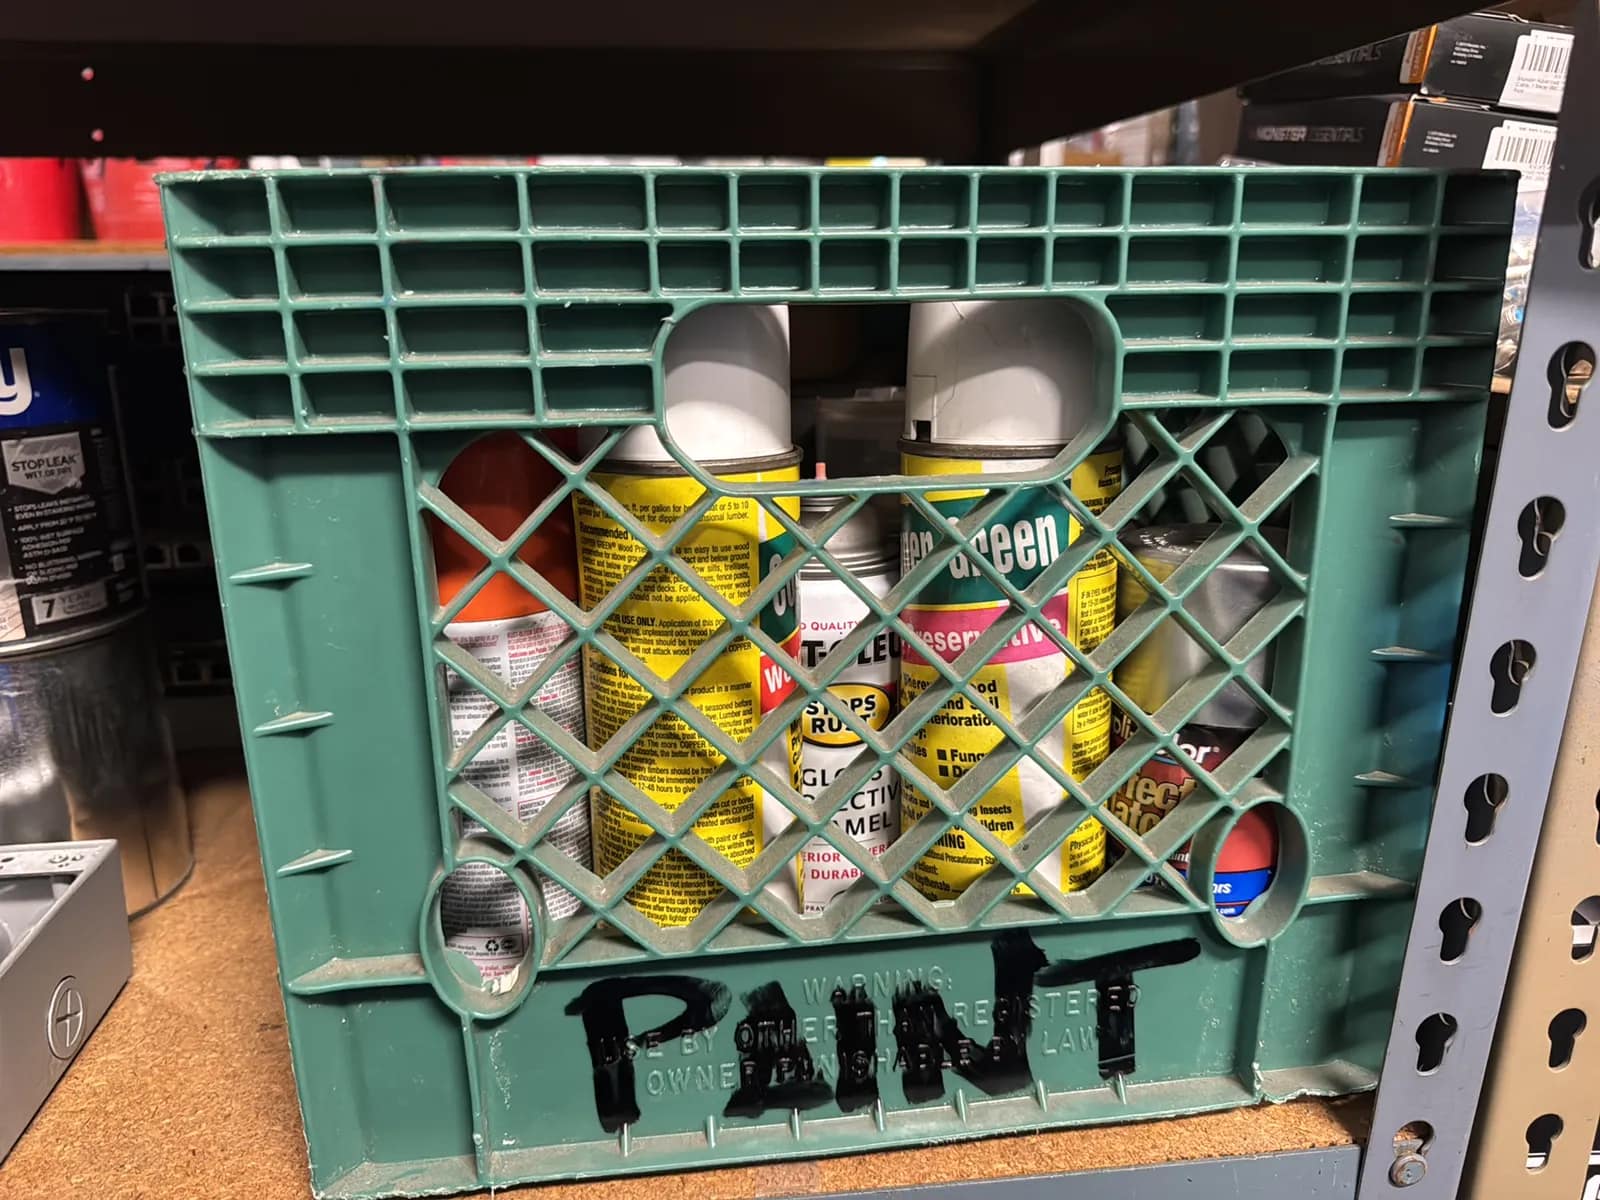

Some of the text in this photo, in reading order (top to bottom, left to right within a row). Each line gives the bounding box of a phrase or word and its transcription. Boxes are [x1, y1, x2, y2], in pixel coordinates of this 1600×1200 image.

[1255, 126, 1307, 142] MONSTER
[651, 504, 671, 513] gallon
[711, 553, 728, 561] below
[730, 552, 749, 561] ground
[42, 600, 56, 618] 7
[621, 614, 634, 624] USE
[637, 616, 656, 626] ONLY.
[660, 620, 693, 628] Application
[641, 628, 673, 636] unpleasant
[653, 647, 671, 655] attack
[728, 642, 751, 652] COPPER
[690, 686, 715, 696] product
[730, 682, 752, 690] manner
[720, 711, 741, 719] Lumber
[680, 740, 706, 748] COPPER
[666, 776, 696, 784] immersed
[639, 783, 655, 792] 12-48
[656, 784, 673, 792] hours
[683, 785, 696, 794] give
[732, 804, 754, 814] COPPER
[980, 805, 1012, 815] Insects
[697, 819, 718, 827] treated
[720, 816, 740, 825] articles
[716, 834, 730, 844] paint
[1070, 836, 1093, 851] Physical
[945, 853, 983, 866] Precautionary
[666, 905, 690, 913] thorough
[805, 904, 825, 912] PRAY
[669, 914, 687, 922] lighter
[803, 965, 952, 1006] WARNING:
[600, 984, 1141, 1066] USE BY OTHER THAN REGISTERED
[564, 932, 1200, 1132] PAINT
[646, 1060, 757, 1096] OWNER
[777, 1038, 973, 1082] PUNISHABLE
[1041, 1025, 1100, 1056] LAW
